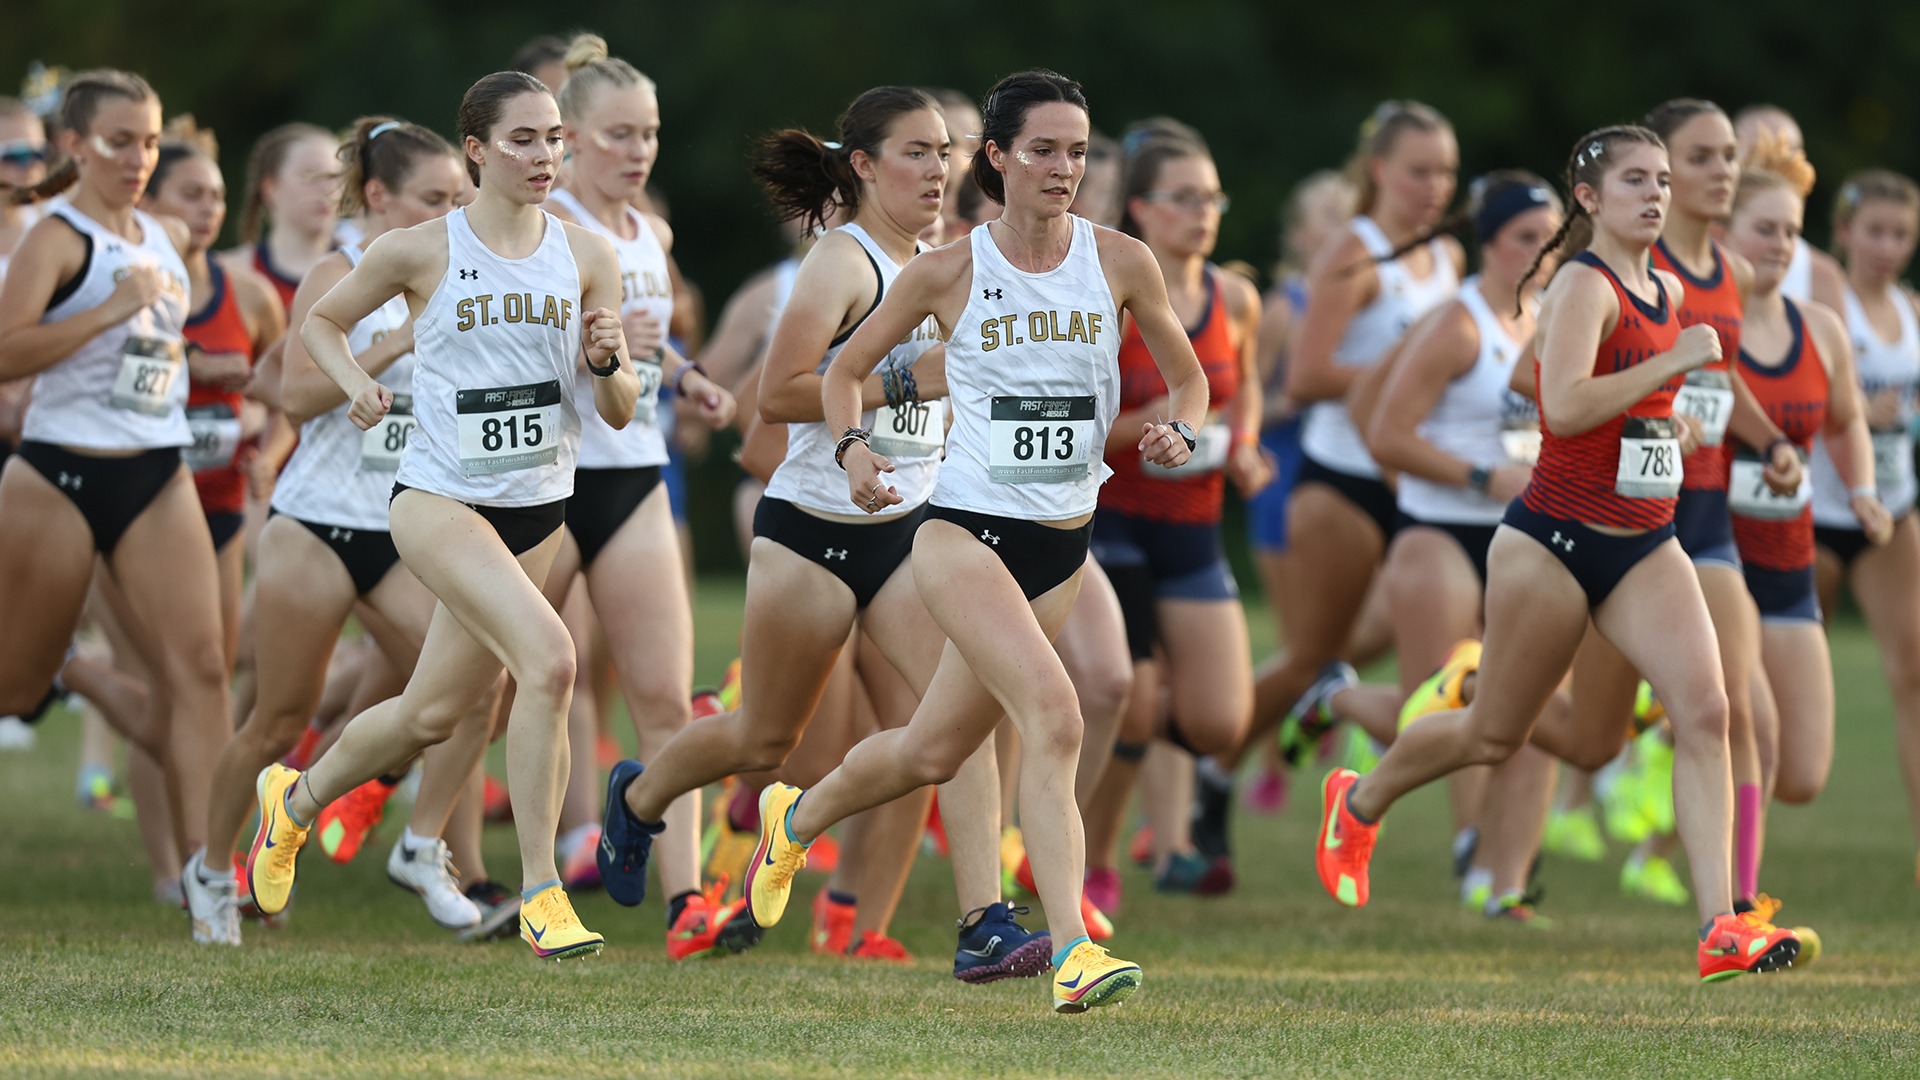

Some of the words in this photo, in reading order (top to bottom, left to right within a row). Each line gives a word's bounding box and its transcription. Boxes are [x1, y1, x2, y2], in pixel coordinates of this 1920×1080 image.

[456, 294, 499, 333] ST.
[503, 293, 573, 332] OLAF
[980, 314, 1024, 353] ST.
[1028, 310, 1103, 346] OLAF
[134, 362, 171, 397] 827
[481, 413, 543, 452] 815
[892, 400, 930, 436] 807
[1012, 426, 1075, 461] 813
[1640, 445, 1673, 477] 783
